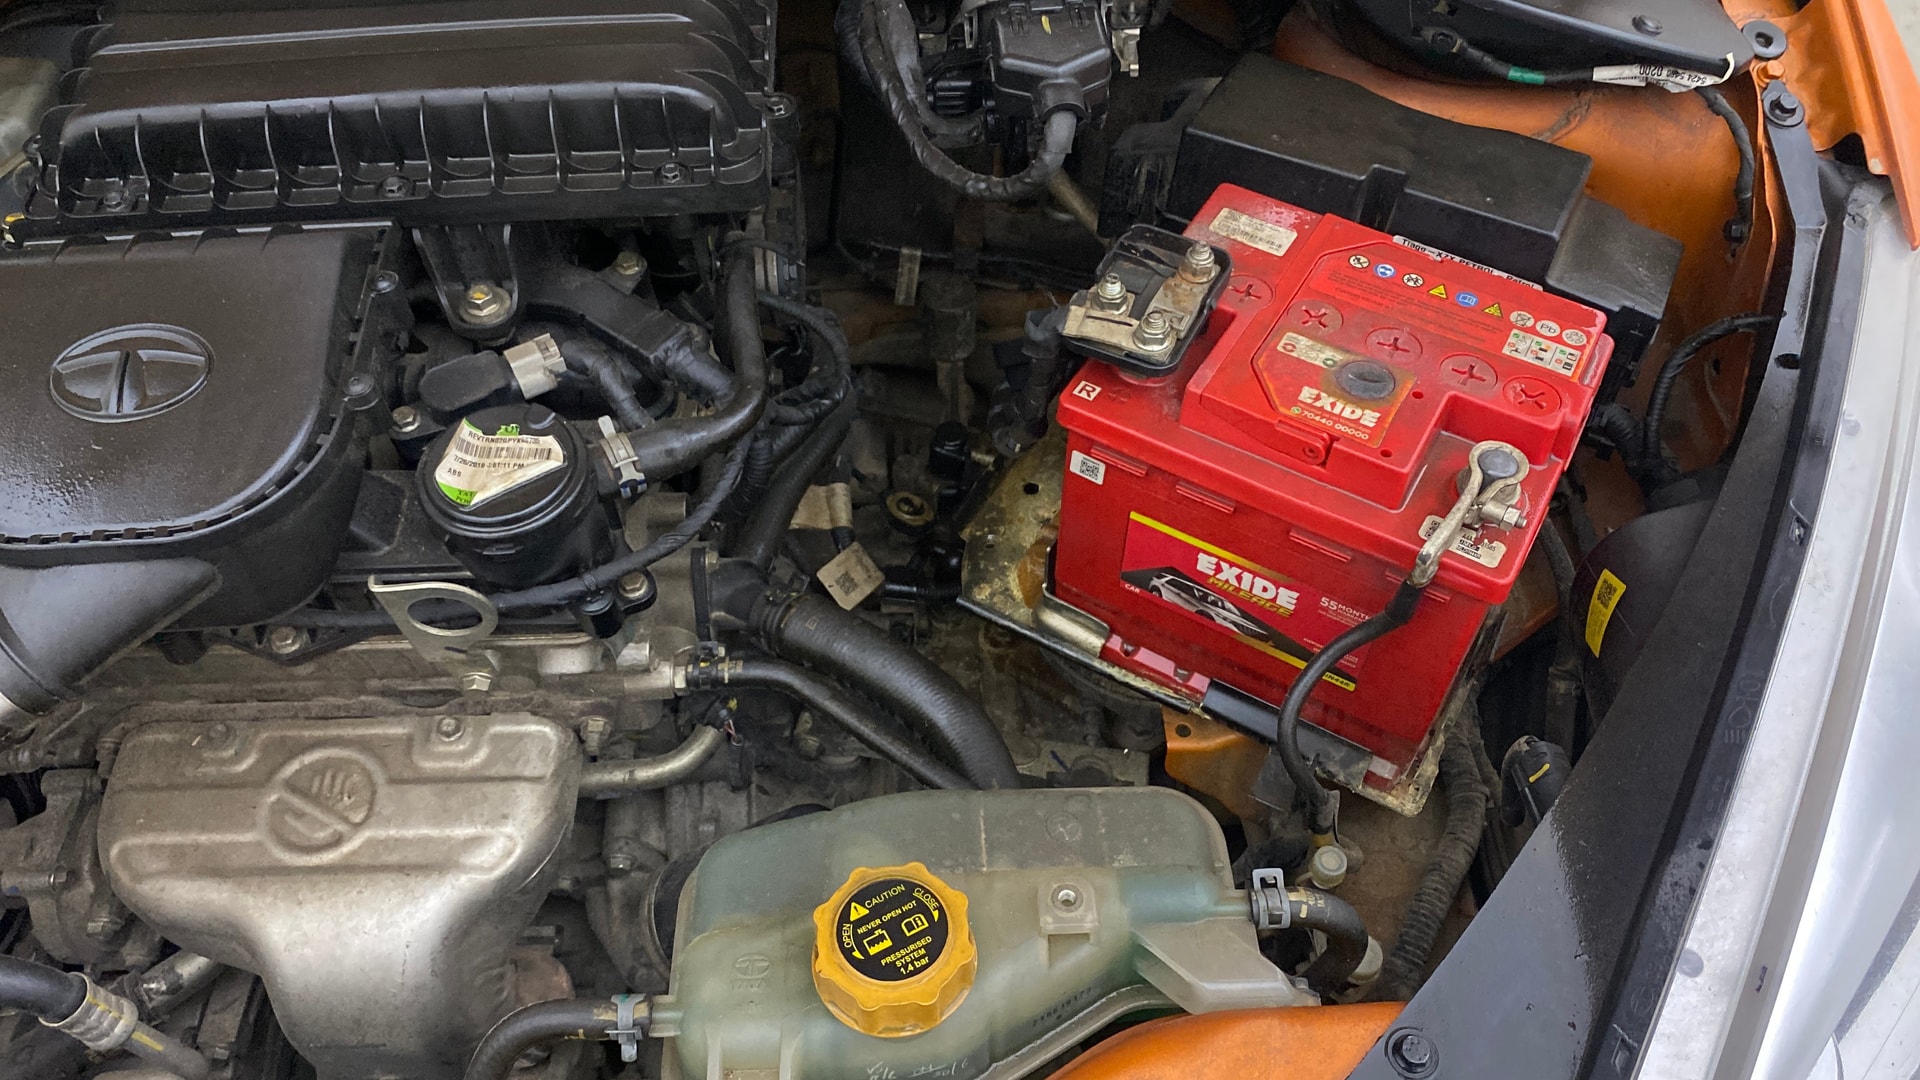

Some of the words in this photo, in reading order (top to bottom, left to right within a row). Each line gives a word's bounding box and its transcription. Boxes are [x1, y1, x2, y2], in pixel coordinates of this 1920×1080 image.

[1639, 65, 1664, 77] 0200
[1540, 323, 1557, 334] Pb
[1078, 383, 1097, 399] R
[1298, 385, 1382, 428] EXIDE
[1301, 410, 1334, 426] 70440
[1334, 423, 1369, 440] 00000
[1124, 583, 1141, 594] CAR
[1197, 552, 1300, 611] EXIDE
[1207, 575, 1295, 618] MILEAGE
[1319, 596, 1338, 611] 55
[865, 884, 905, 908] CAUTION
[914, 887, 939, 910] CLOSE
[857, 919, 881, 934] NEVER
[881, 909, 902, 923] OPEN
[901, 899, 918, 913] HOT
[842, 923, 852, 948] OPEN
[881, 936, 932, 966] PRESSURISED
[896, 948, 926, 967] SYSTEM
[900, 963, 914, 975] 1.4
[914, 956, 930, 969] bar
